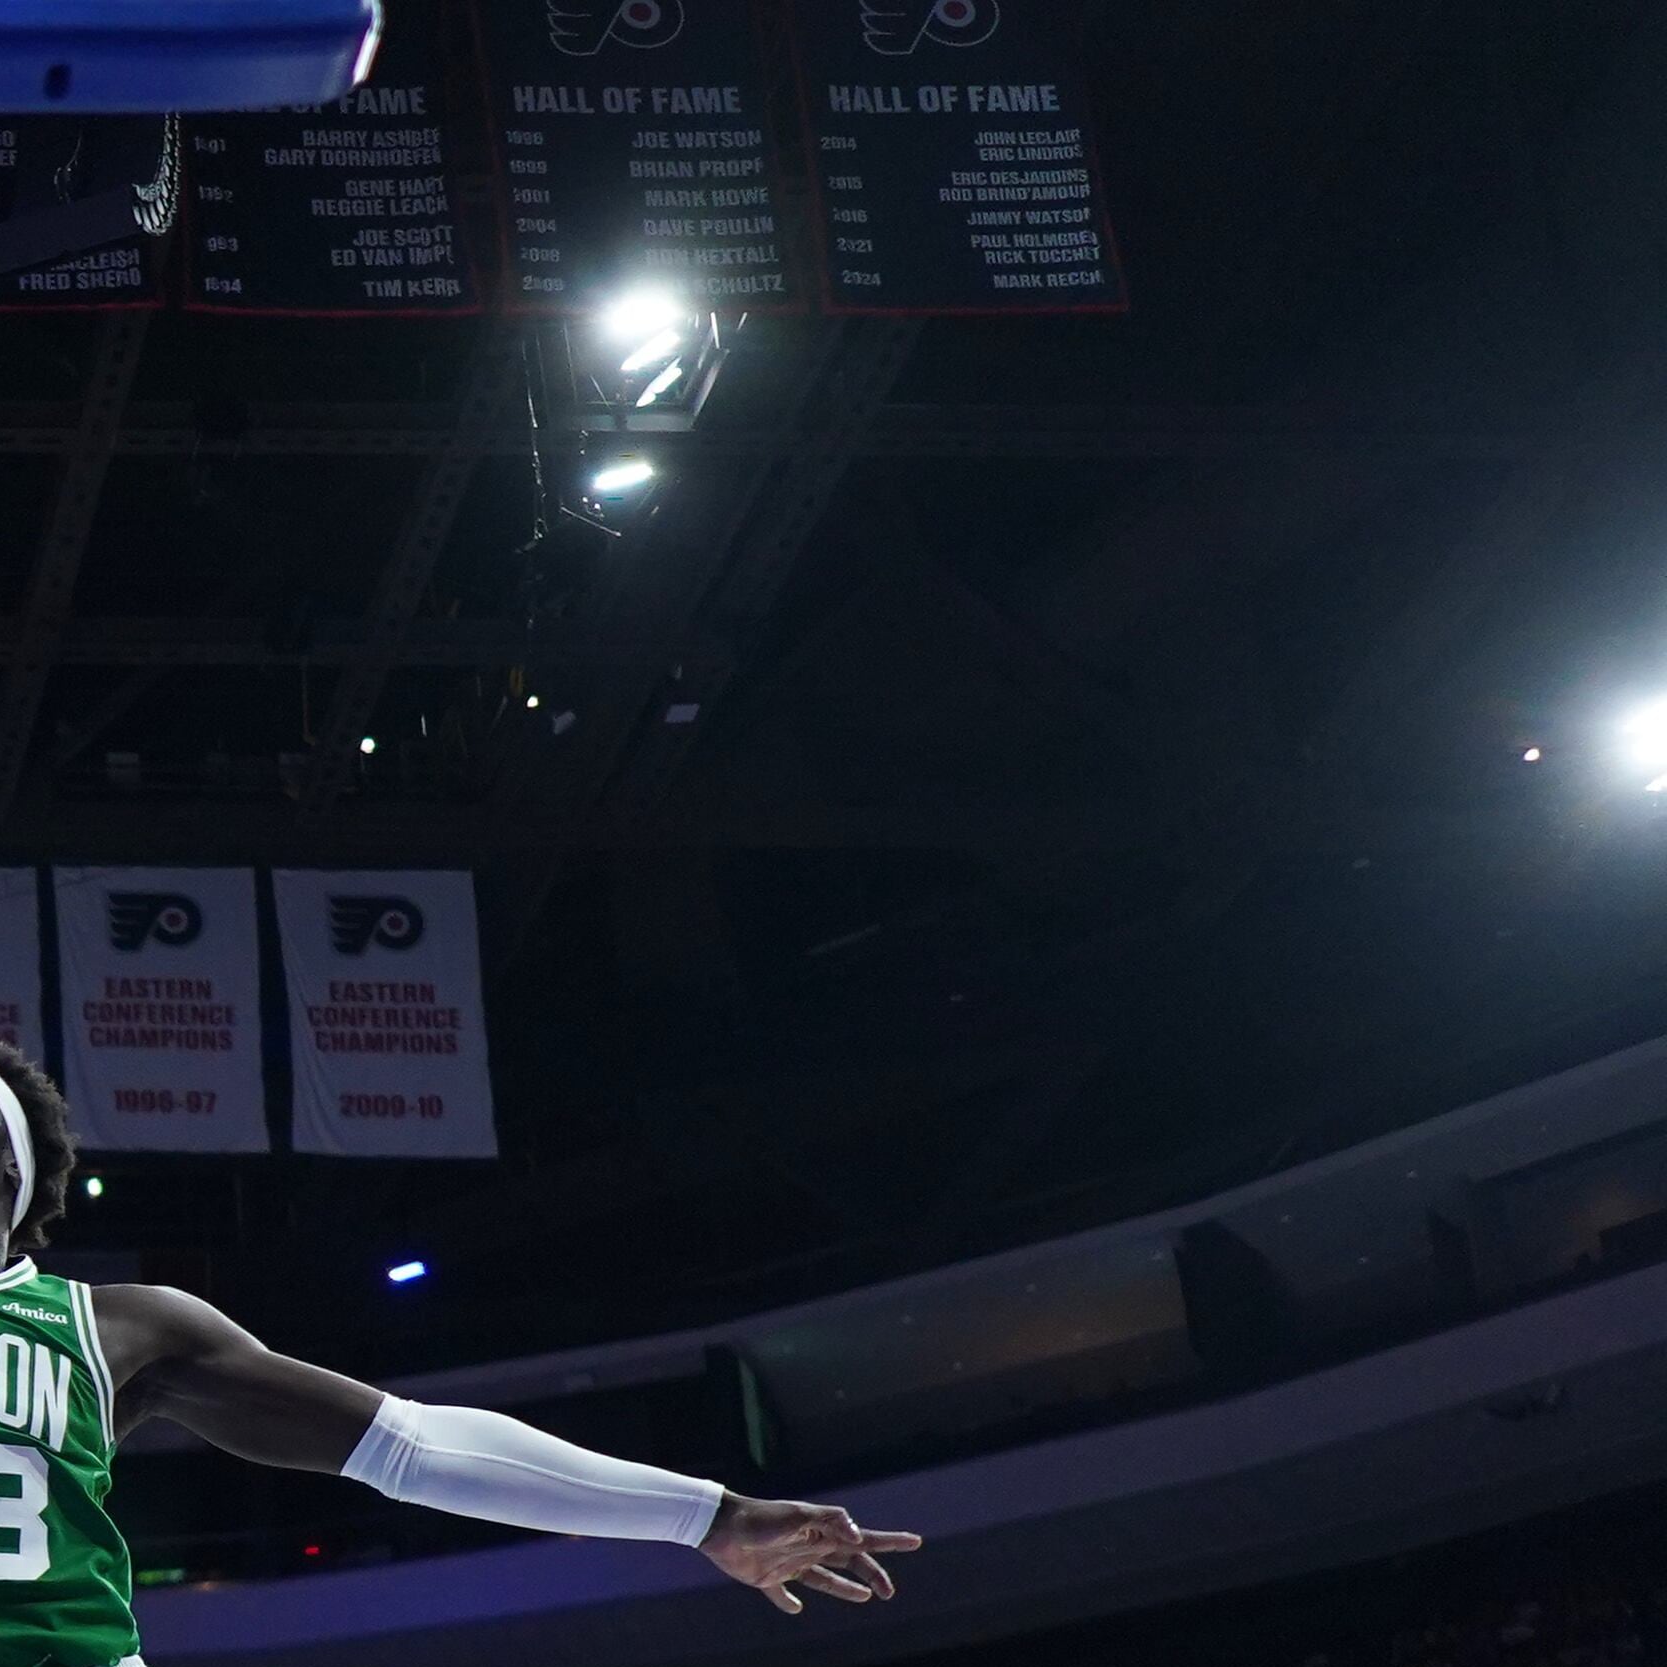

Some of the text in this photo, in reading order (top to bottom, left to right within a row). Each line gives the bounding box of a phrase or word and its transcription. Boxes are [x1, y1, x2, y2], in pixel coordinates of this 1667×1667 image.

[339, 87, 426, 115] FAME
[513, 86, 742, 114] HALL OF FAME
[828, 84, 1060, 113] HALL OF FAME
[302, 130, 368, 148] BARRY
[632, 129, 762, 148] JOE WATSON
[974, 129, 1081, 146] JOHN LECLAIR
[265, 149, 315, 166] GARY
[979, 144, 1083, 161] ERIC LINDROS
[629, 160, 694, 177] BRIAN
[951, 169, 1088, 185] ERIC DESJARDINS
[345, 179, 395, 197] GENE
[939, 187, 975, 202] ROD
[645, 189, 706, 207] MARK
[312, 199, 384, 216] REGGIE
[967, 210, 1022, 226] JIMMY
[353, 229, 390, 247] JOE
[971, 234, 1012, 249] PAUL
[331, 249, 357, 266] ED
[362, 248, 404, 266] VAN
[984, 250, 1025, 264] RICK
[363, 280, 402, 298] TIM
[993, 274, 1042, 289] MARK
[104, 978, 213, 1001] EASTERN
[329, 981, 436, 1004] EASTERN
[83, 1002, 236, 1027] CONFERENCE
[307, 1005, 461, 1030] CONFERENCE
[90, 1026, 234, 1051] CHAMPIONS
[315, 1031, 459, 1054] CHAMPIONS
[1, 1302, 69, 1325] Amica
